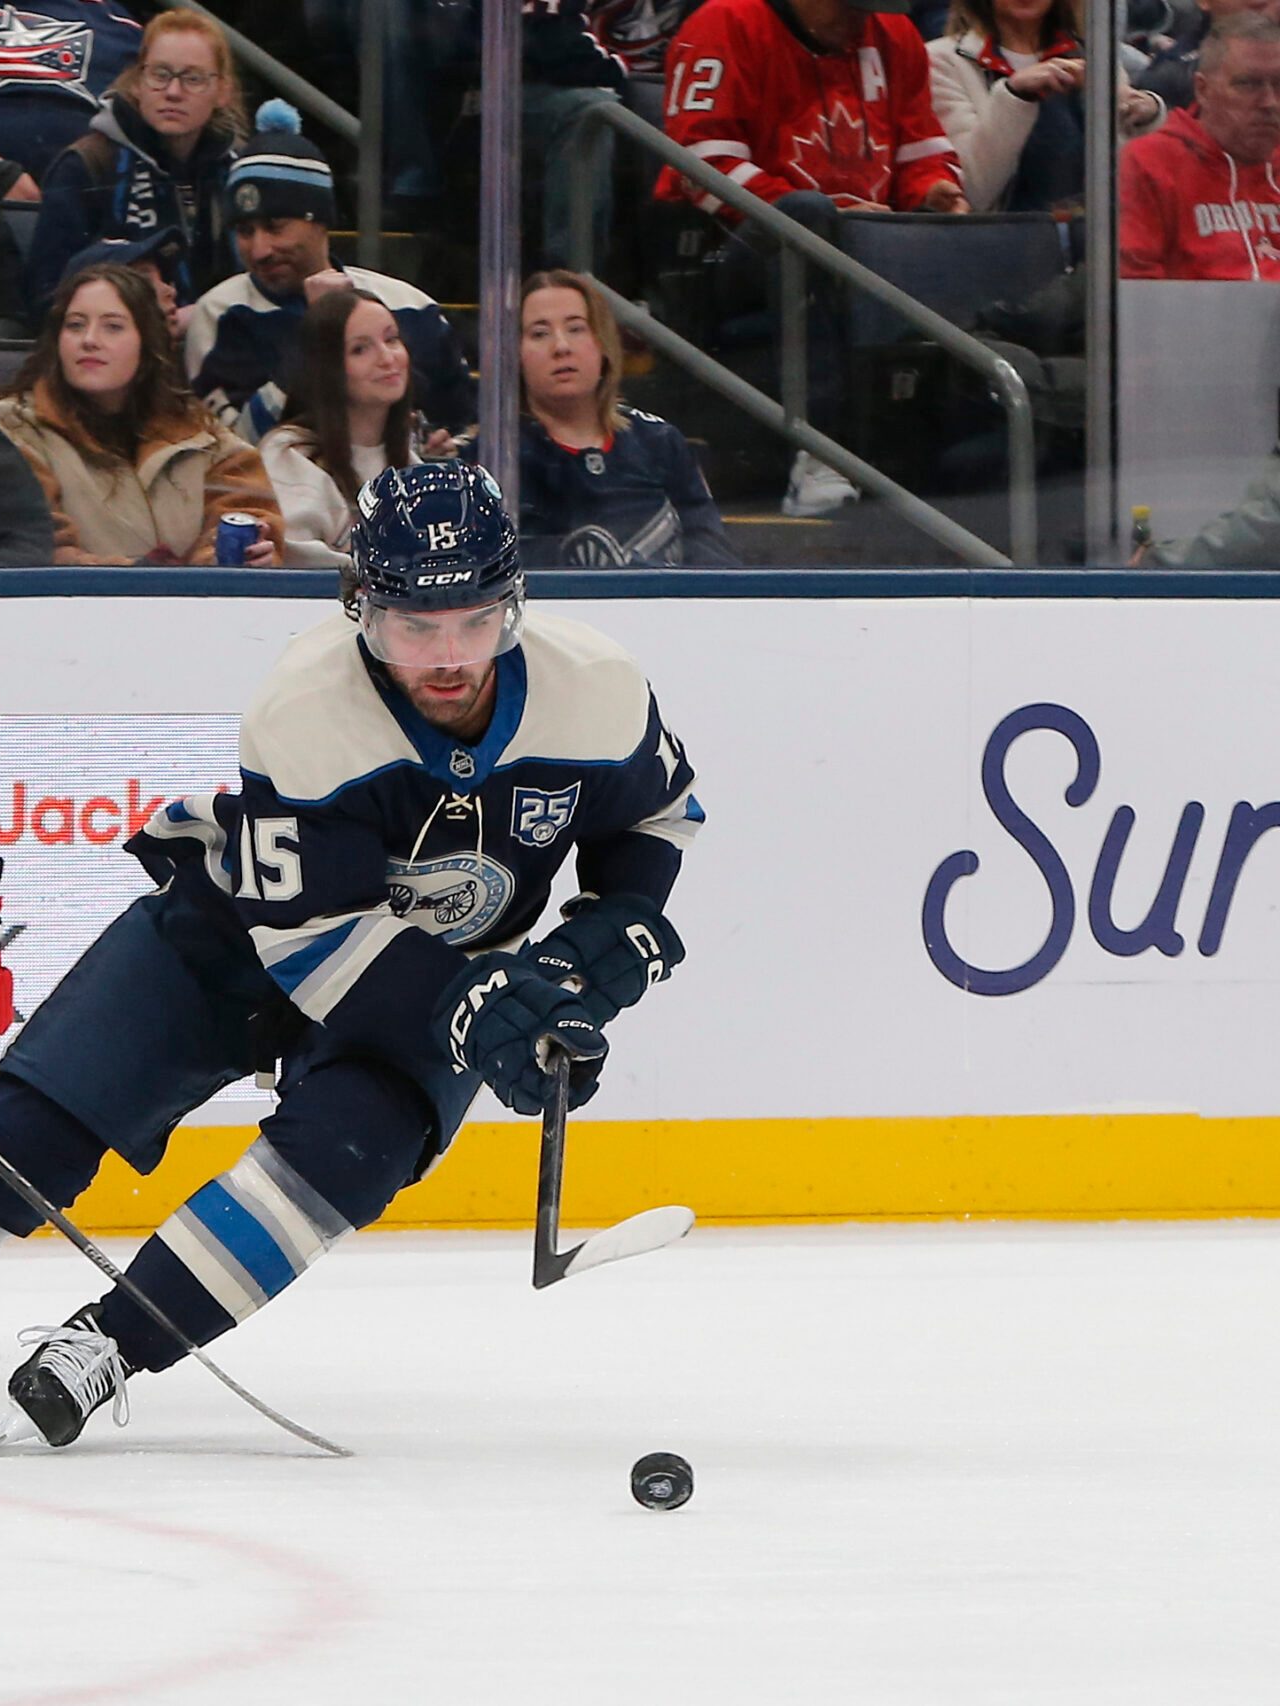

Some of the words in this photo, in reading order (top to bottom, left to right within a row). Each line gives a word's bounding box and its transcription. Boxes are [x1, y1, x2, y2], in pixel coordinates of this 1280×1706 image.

[666, 56, 724, 117] 12
[857, 46, 888, 102] A
[426, 520, 460, 552] 15
[416, 570, 474, 587] CCM
[654, 728, 682, 791] 1
[519, 795, 571, 832] 25
[234, 812, 304, 901] 15
[921, 701, 1280, 997] Sur
[537, 955, 574, 971] CCM
[624, 922, 665, 988] CC
[556, 1019, 595, 1032] CCM
